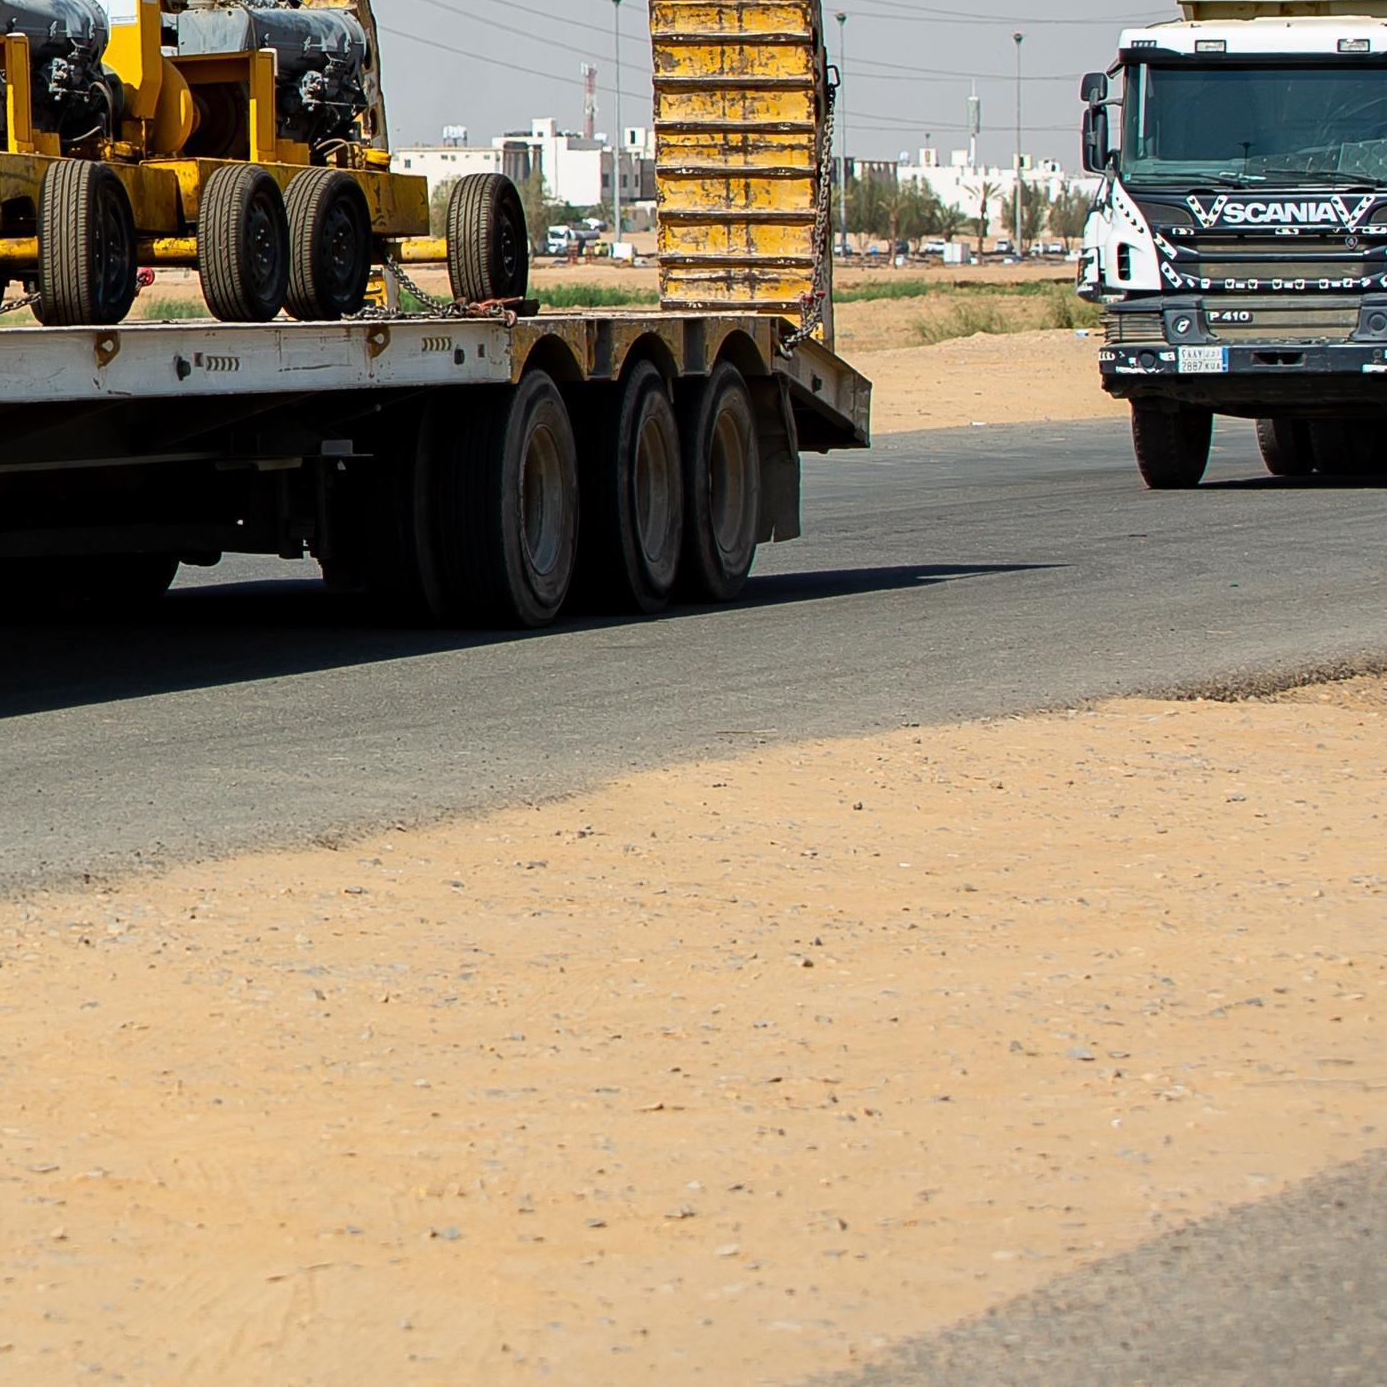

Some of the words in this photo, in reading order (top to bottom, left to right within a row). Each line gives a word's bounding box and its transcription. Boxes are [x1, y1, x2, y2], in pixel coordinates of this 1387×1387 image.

[1222, 202, 1338, 223] SCANIA
[1209, 311, 1220, 321] P
[1222, 311, 1250, 321] 410
